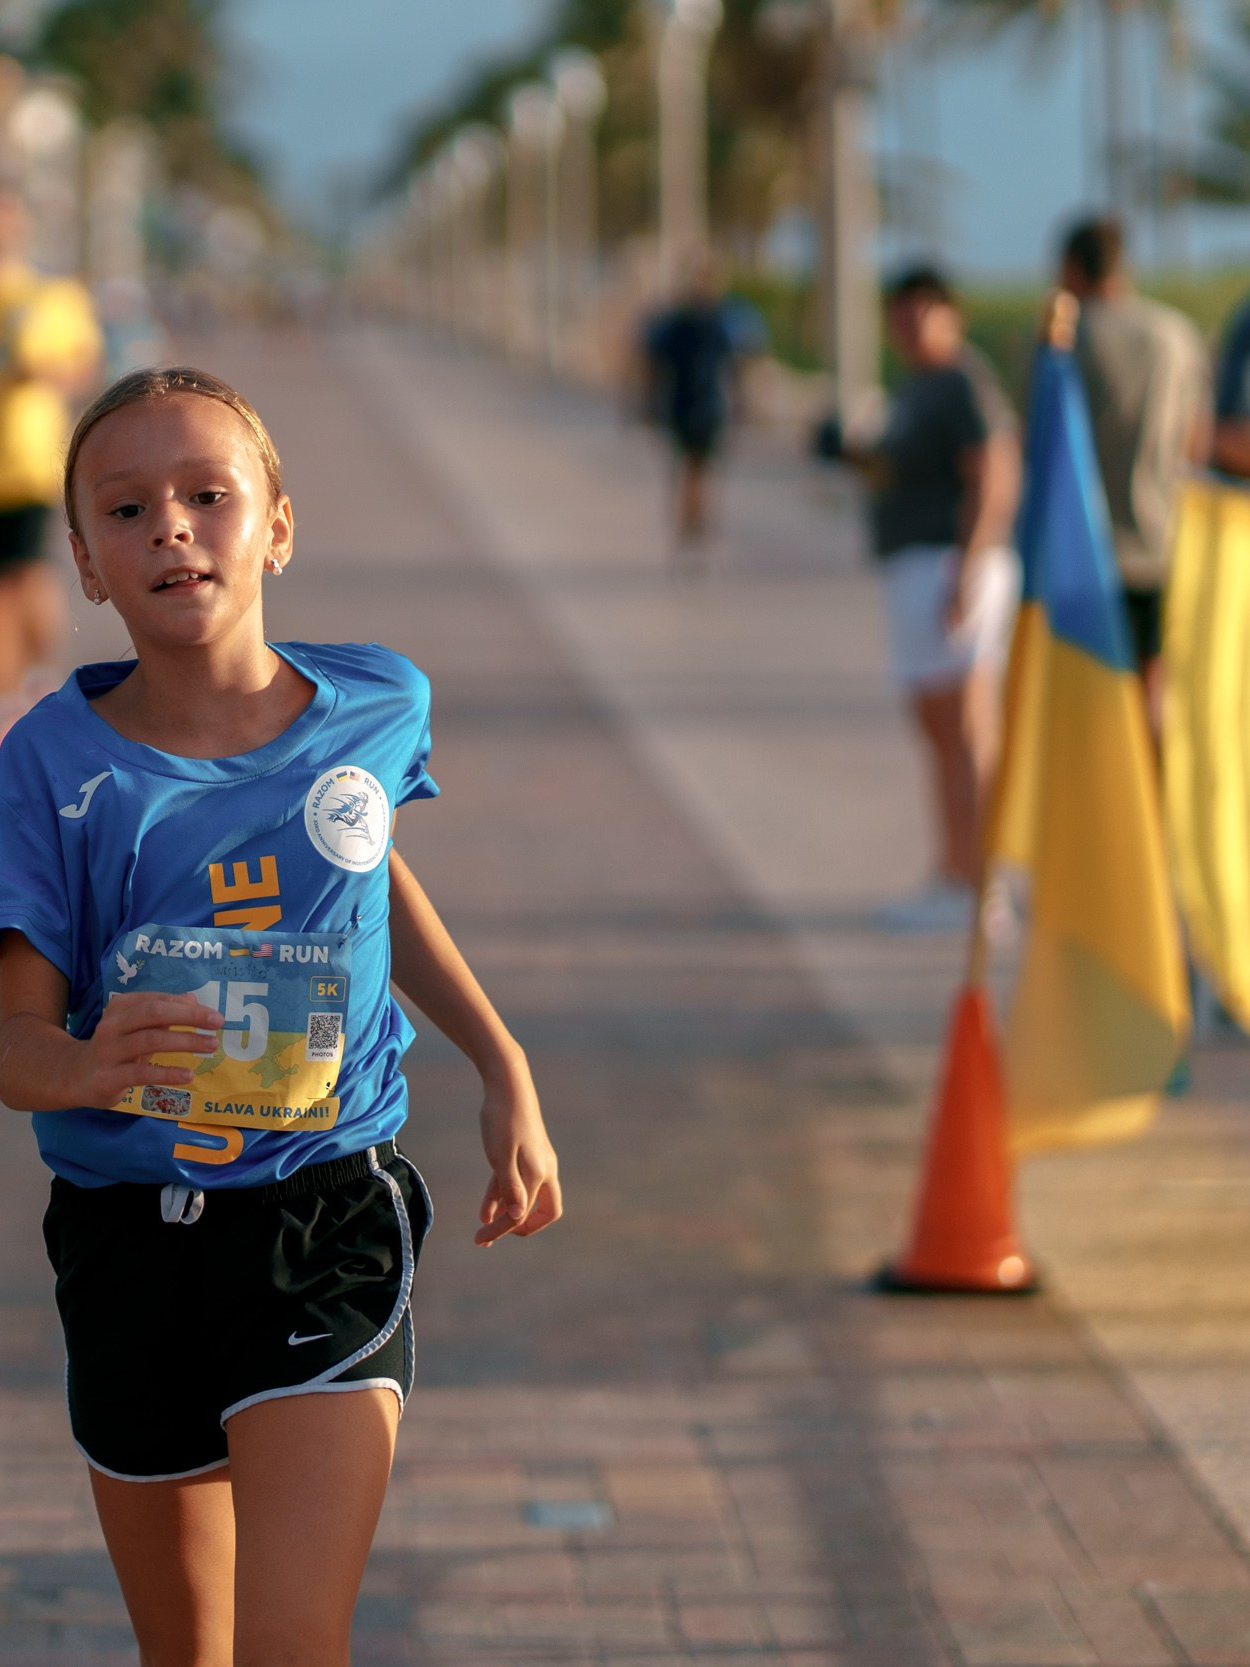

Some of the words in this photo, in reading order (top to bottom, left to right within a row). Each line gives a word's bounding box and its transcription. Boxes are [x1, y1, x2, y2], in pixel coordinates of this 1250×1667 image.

[312, 778, 335, 809] RAZOM
[364, 777, 380, 795] RUN
[135, 933, 223, 960] RAZOM
[279, 944, 329, 964] RUN
[317, 983, 338, 996] 5K
[187, 980, 270, 1062] 15
[204, 1101, 255, 1116] SLAVA
[260, 1105, 330, 1118] UKRAINI!
